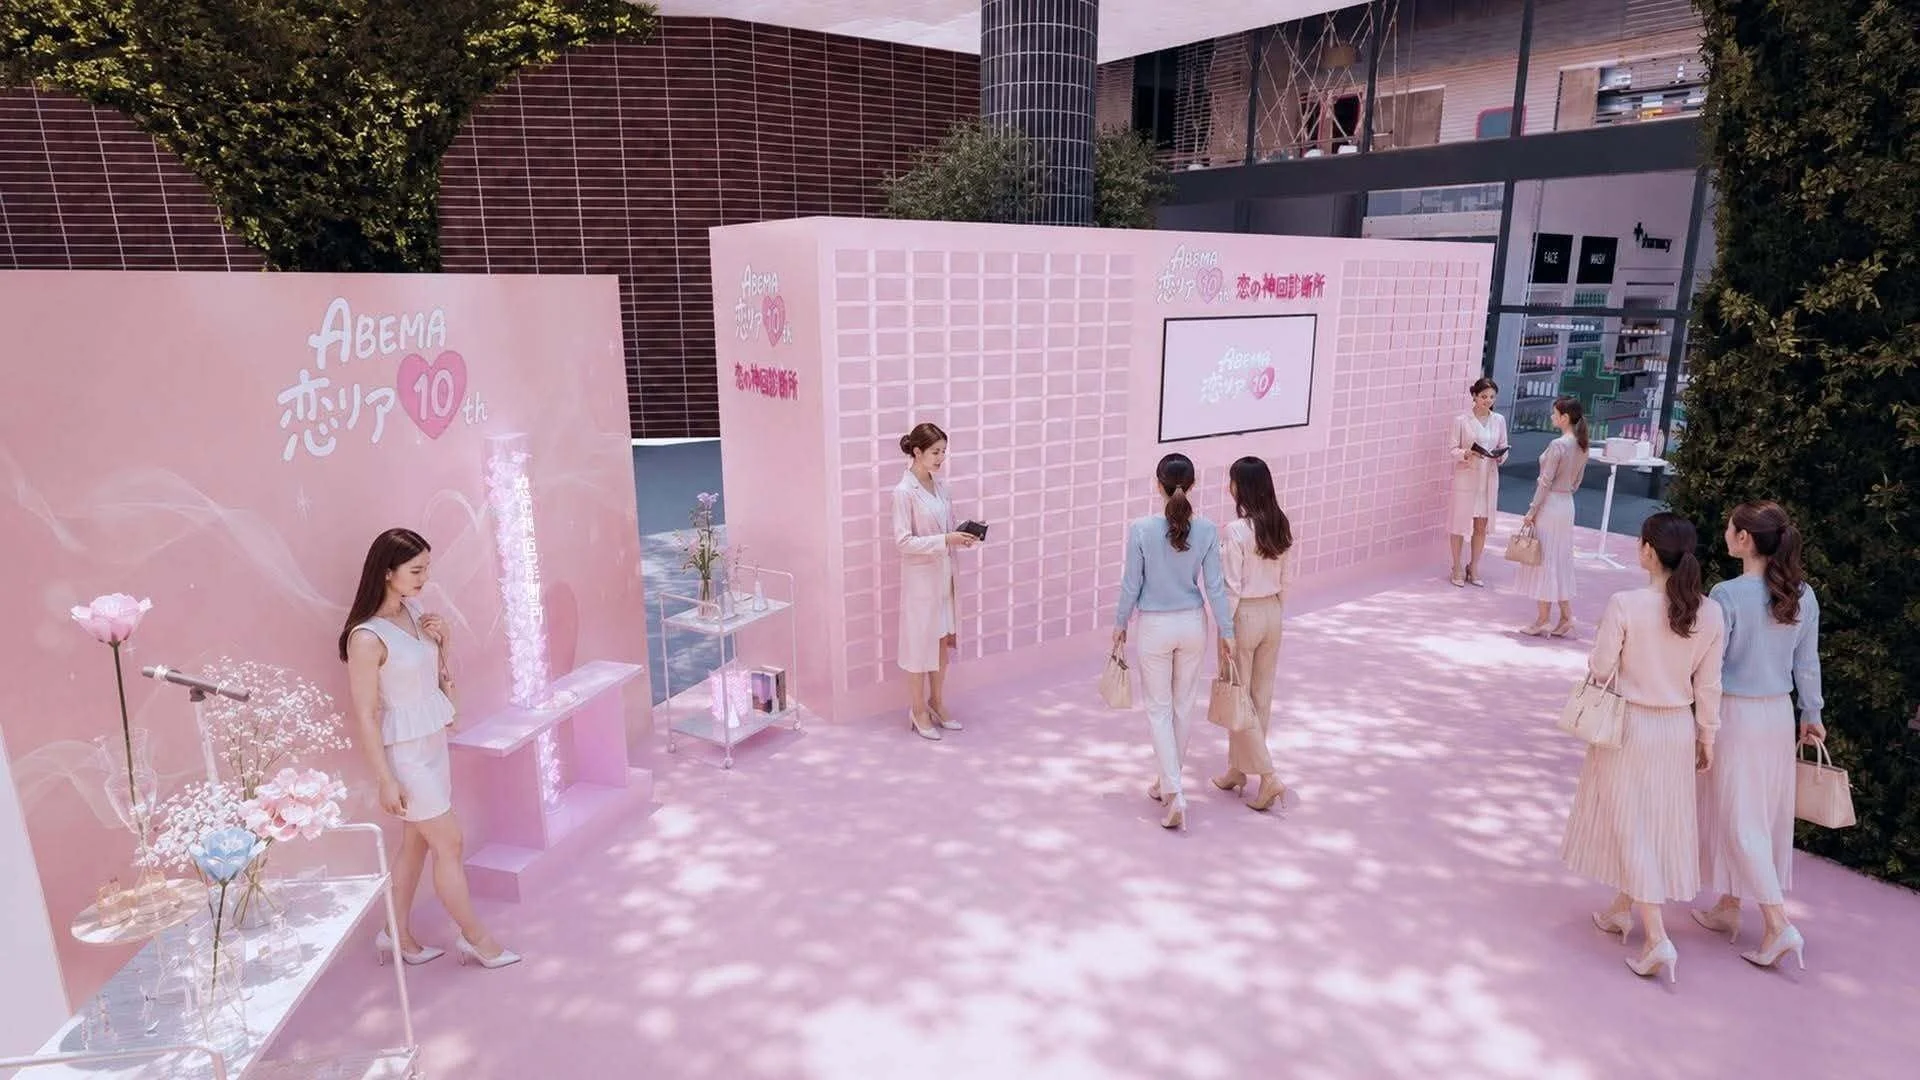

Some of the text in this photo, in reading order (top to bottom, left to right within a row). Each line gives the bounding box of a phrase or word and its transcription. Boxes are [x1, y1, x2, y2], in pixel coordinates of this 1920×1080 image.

[1169, 244, 1218, 271] ABEMA
[741, 264, 779, 298] ABEMA
[1236, 272, 1326, 301] 恋の神回診断所
[308, 297, 448, 370] ABEMA
[277, 369, 396, 462] 恋リア
